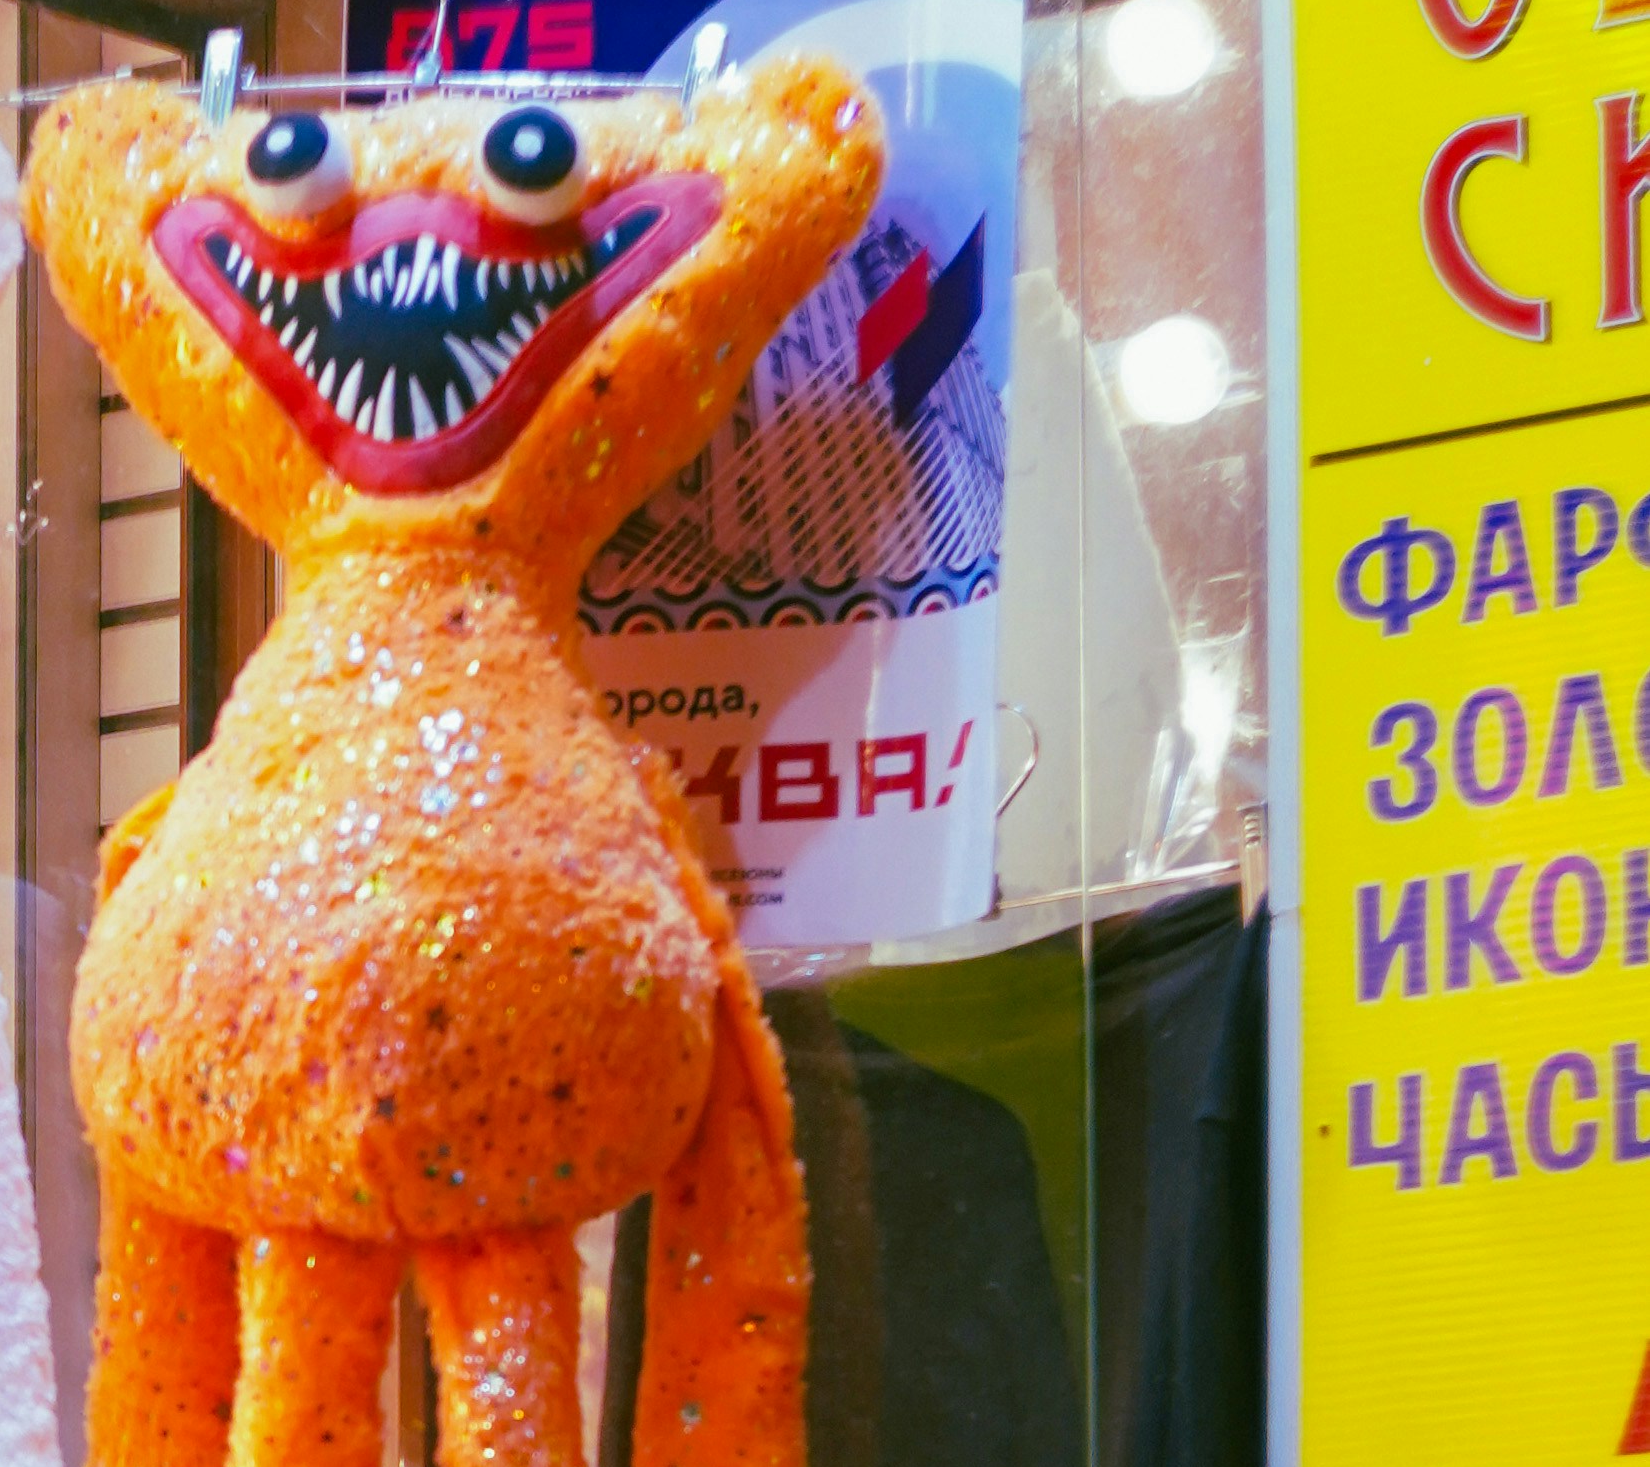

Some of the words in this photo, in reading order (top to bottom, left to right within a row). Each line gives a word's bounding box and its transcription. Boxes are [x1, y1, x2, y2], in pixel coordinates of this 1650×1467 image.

[1336, 486, 1650, 638] ФАР
[604, 684, 759, 727] орода,
[1367, 669, 1650, 823] ЗОЛ
[668, 720, 974, 825] КВА!
